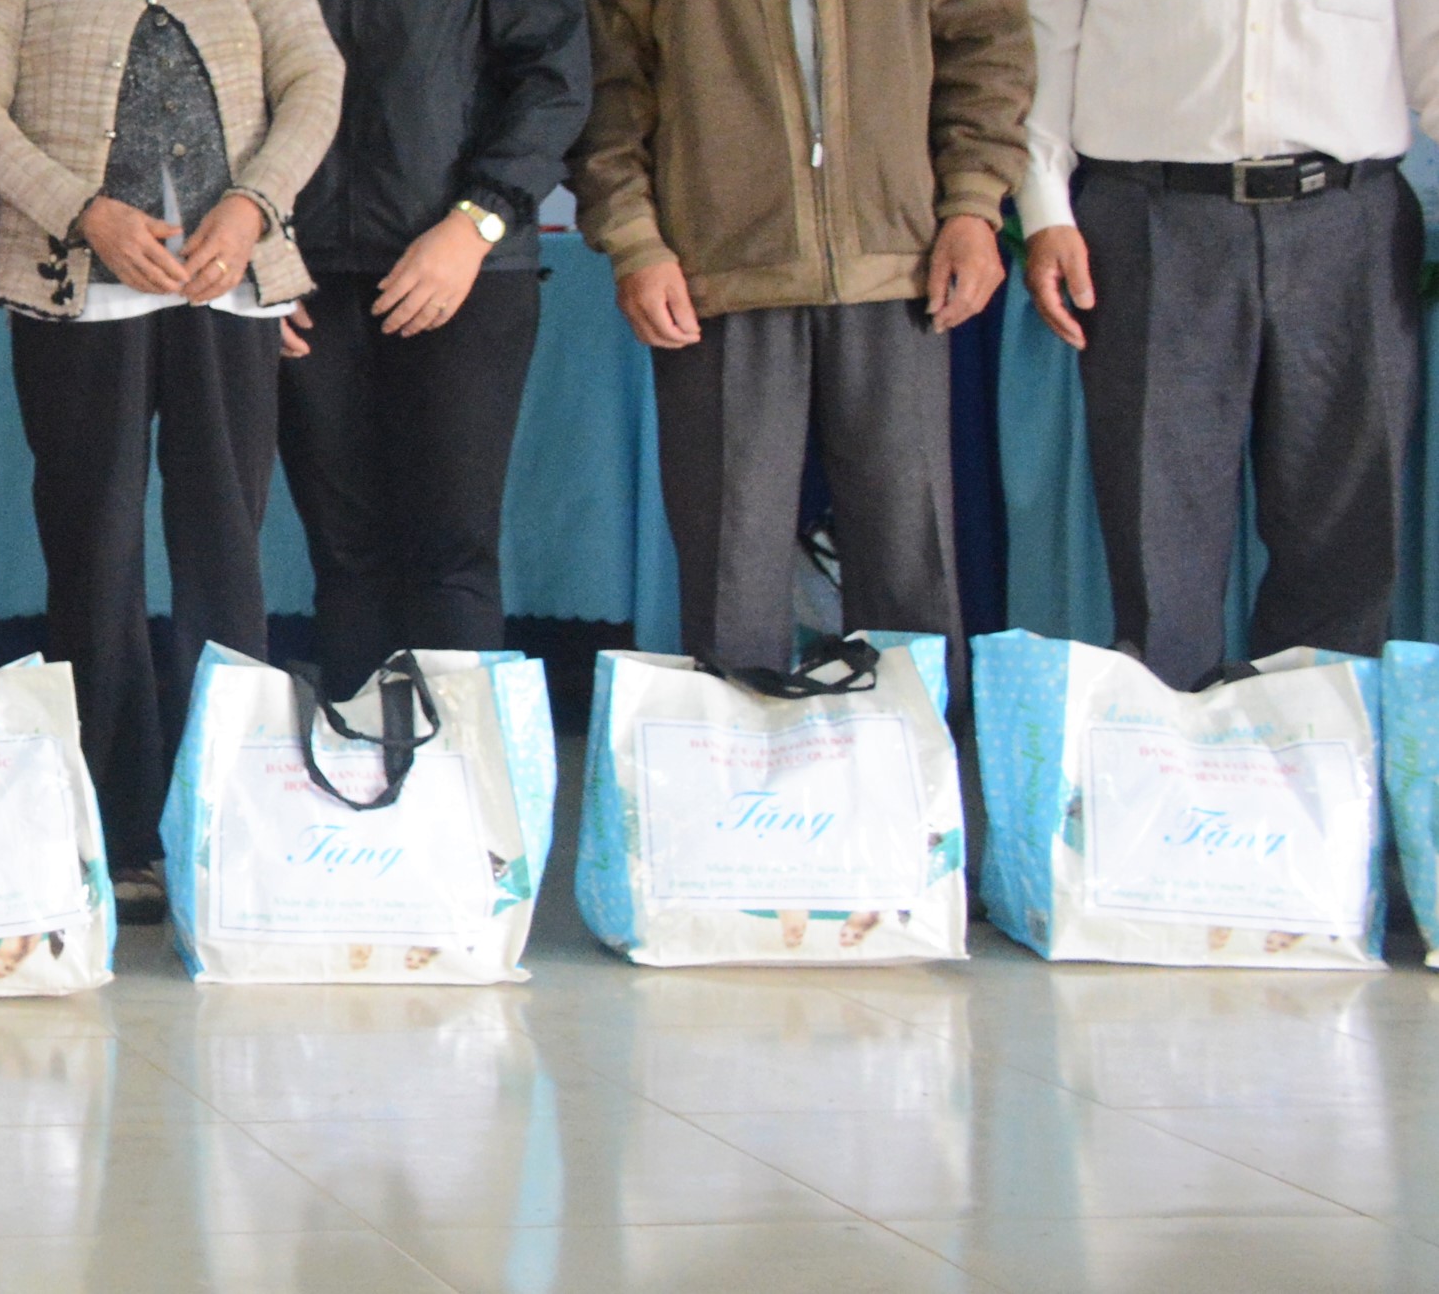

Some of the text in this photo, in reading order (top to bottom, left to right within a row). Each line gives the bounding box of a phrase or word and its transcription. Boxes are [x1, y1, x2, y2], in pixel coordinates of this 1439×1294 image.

[715, 789, 836, 845] Tặng
[1162, 805, 1288, 859] Tặng
[285, 823, 405, 881] Tặng
